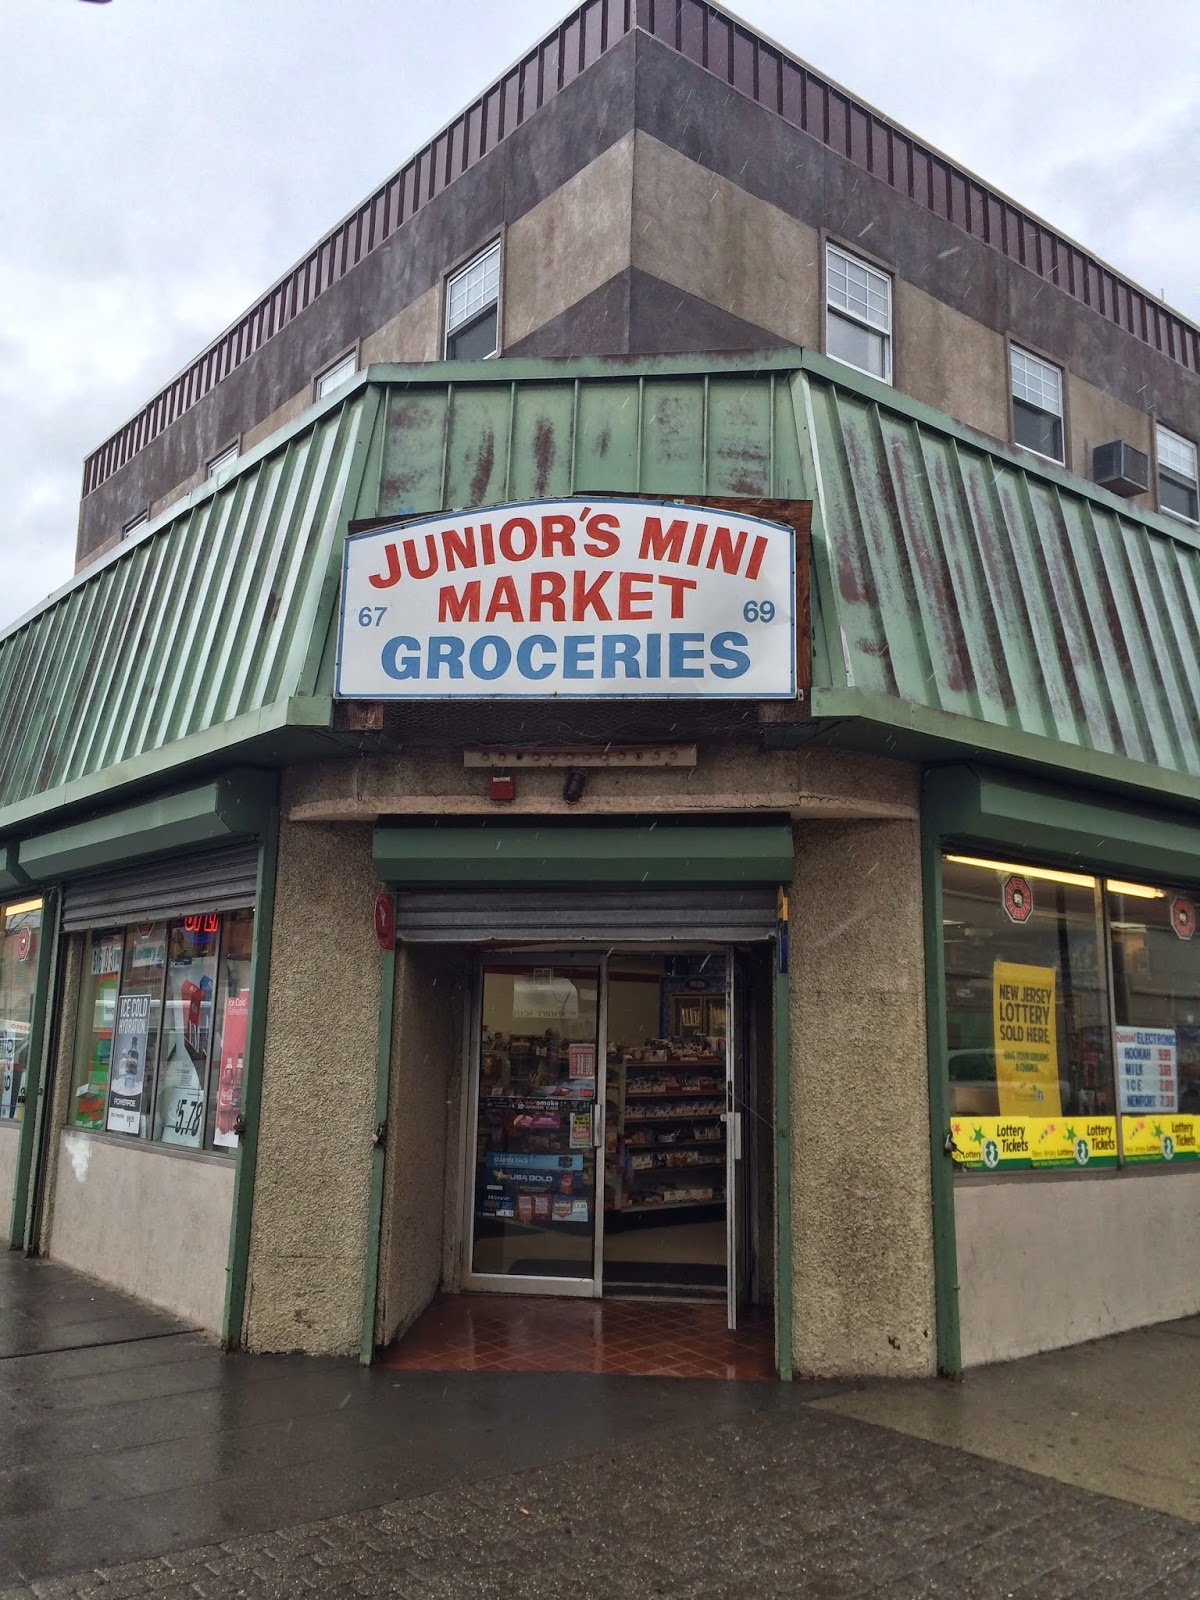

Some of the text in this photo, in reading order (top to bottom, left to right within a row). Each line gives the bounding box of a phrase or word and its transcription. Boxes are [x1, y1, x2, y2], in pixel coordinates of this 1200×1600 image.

[368, 507, 769, 589] JUNIOR'S MINI
[438, 570, 698, 623] MARKET
[358, 606, 387, 628] 67
[743, 600, 775, 623] 69
[381, 631, 751, 680] GROCERIES
[999, 984, 1052, 1004] NEW JERSEY
[120, 997, 148, 1018] ICE COLD
[999, 1002, 1051, 1026] LOTTERY
[1000, 1024, 1024, 1042] SOLD
[1124, 1047, 1151, 1061] HOOKAH
[1125, 1063, 1143, 1076] MILK
[1126, 1079, 1143, 1092] ICE
[113, 1098, 137, 1108] POWERADE
[996, 1124, 1026, 1140] Lottery
[1086, 1124, 1113, 1139] Lottery
[1171, 1122, 1194, 1138] Lottery
[1001, 1139, 1029, 1153] Tickets
[1091, 1137, 1116, 1151] Tickets
[1175, 1134, 1197, 1147] Tickets
[509, 1173, 553, 1183] USA GOLD
